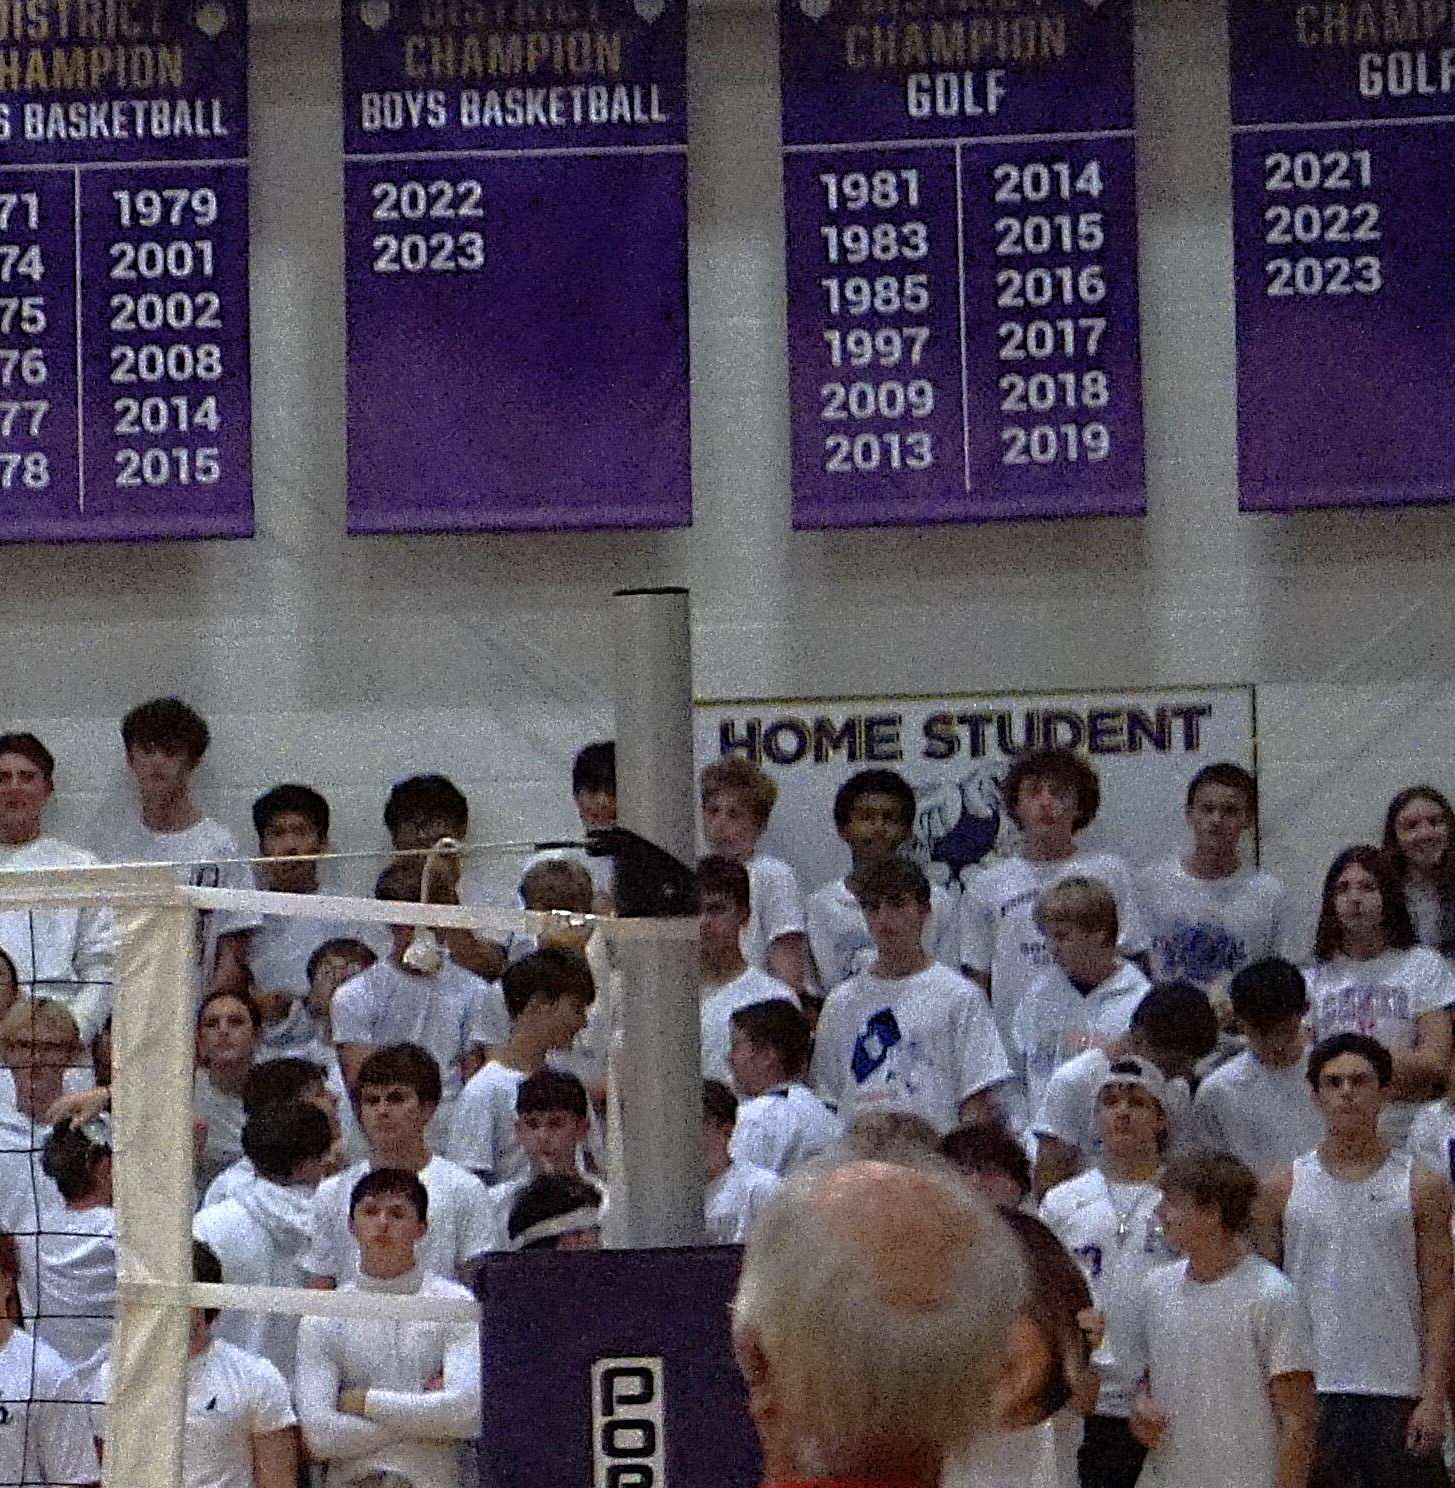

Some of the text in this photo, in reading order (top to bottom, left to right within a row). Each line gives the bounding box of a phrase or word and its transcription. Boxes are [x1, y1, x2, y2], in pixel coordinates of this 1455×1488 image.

[406, 31, 621, 77] CHAMPION
[846, 16, 1066, 67] CHAMPION
[363, 86, 666, 130] BOYS BASKETBALL
[908, 71, 1004, 117] GOLF
[25, 100, 227, 140] BASKETBALL
[821, 170, 918, 209] 1981
[995, 161, 1103, 201] 2014
[1265, 150, 1370, 190] 2021
[114, 189, 217, 226] 1979
[373, 180, 483, 219] 2022
[821, 223, 928, 262] 1983
[996, 213, 1104, 254] 2015
[1266, 203, 1380, 243] 2022
[111, 241, 212, 278] 2001
[373, 232, 484, 271] 2023
[822, 275, 928, 314] 1985
[997, 266, 1105, 306] 2016
[1266, 256, 1382, 296] 2023
[111, 293, 221, 330] 2002
[825, 327, 929, 366] 1997
[999, 318, 1106, 359] 2017
[111, 344, 222, 381] 2008
[822, 380, 934, 419] 2009
[1000, 371, 1109, 411] 2018
[115, 397, 220, 433] 2014
[826, 432, 933, 471] 2013
[1002, 423, 1109, 463] 2019
[116, 448, 220, 485] 2015
[719, 704, 1212, 764] HOME STUDENT
